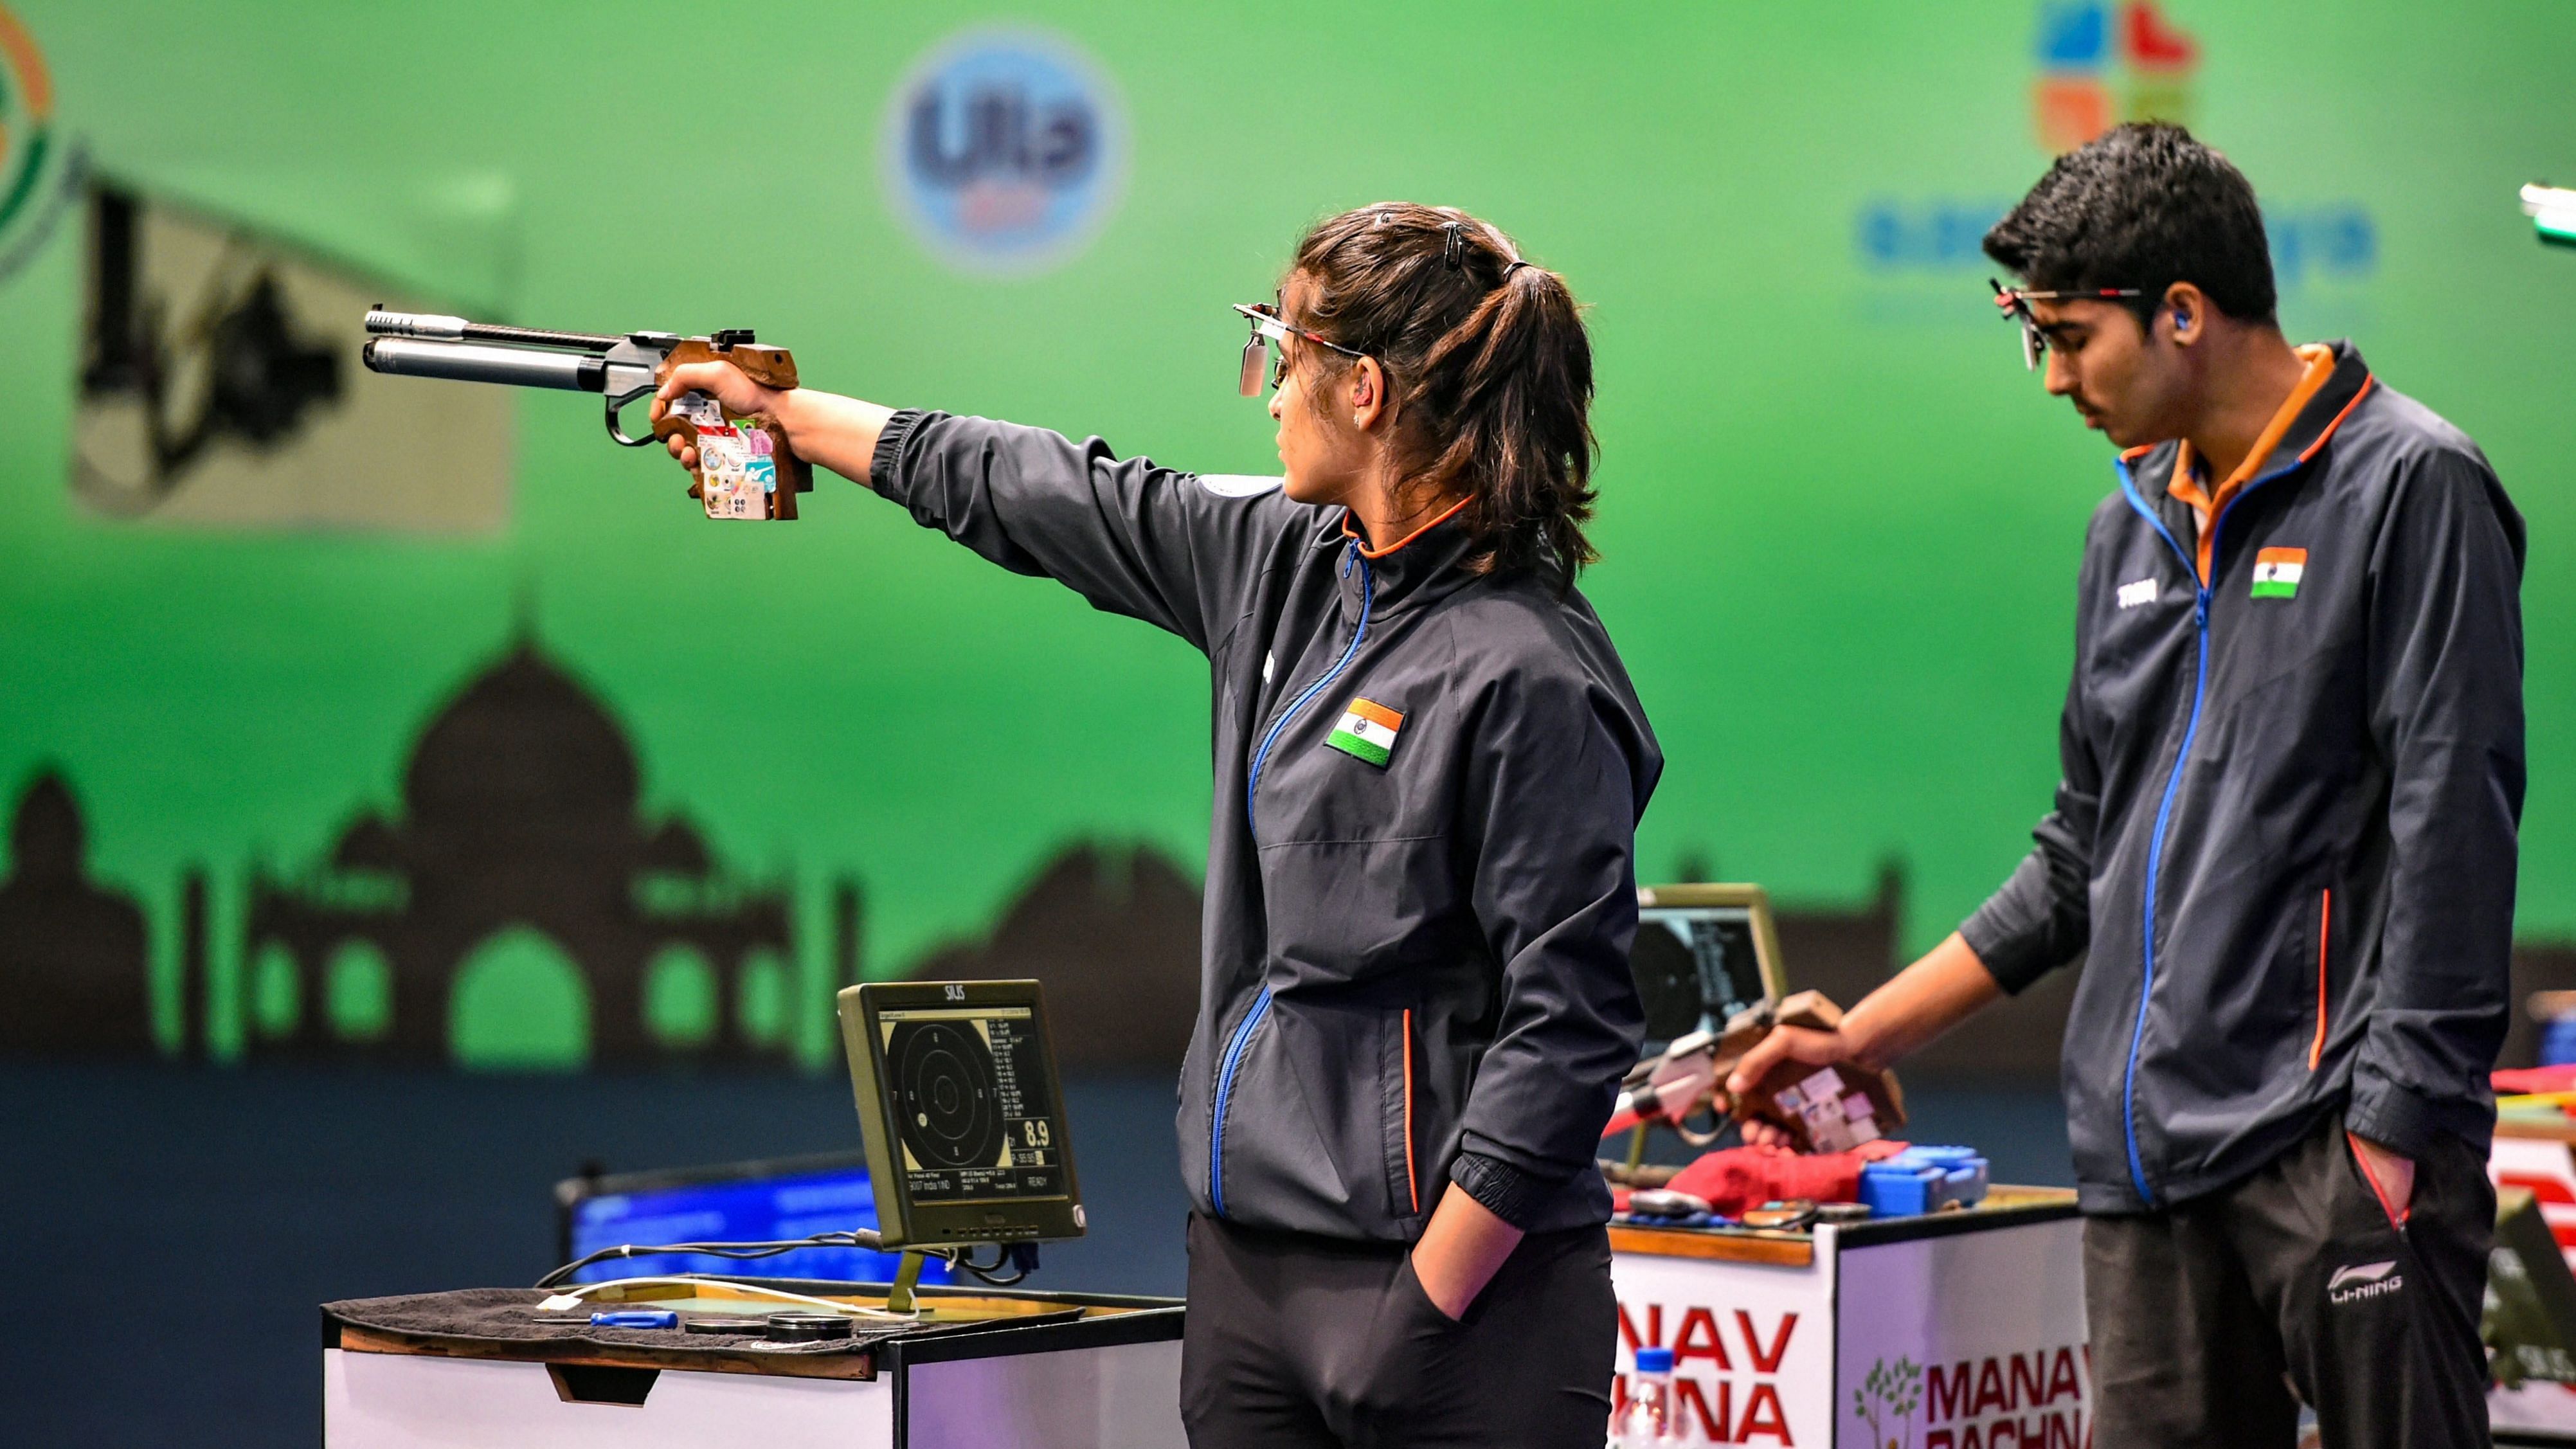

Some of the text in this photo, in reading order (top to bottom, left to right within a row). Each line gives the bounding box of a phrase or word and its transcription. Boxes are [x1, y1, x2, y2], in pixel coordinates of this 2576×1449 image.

[945, 985, 966, 1000] SIUS
[1024, 1120, 1050, 1147] 8.9
[2330, 1275, 2402, 1305] LI-NING
